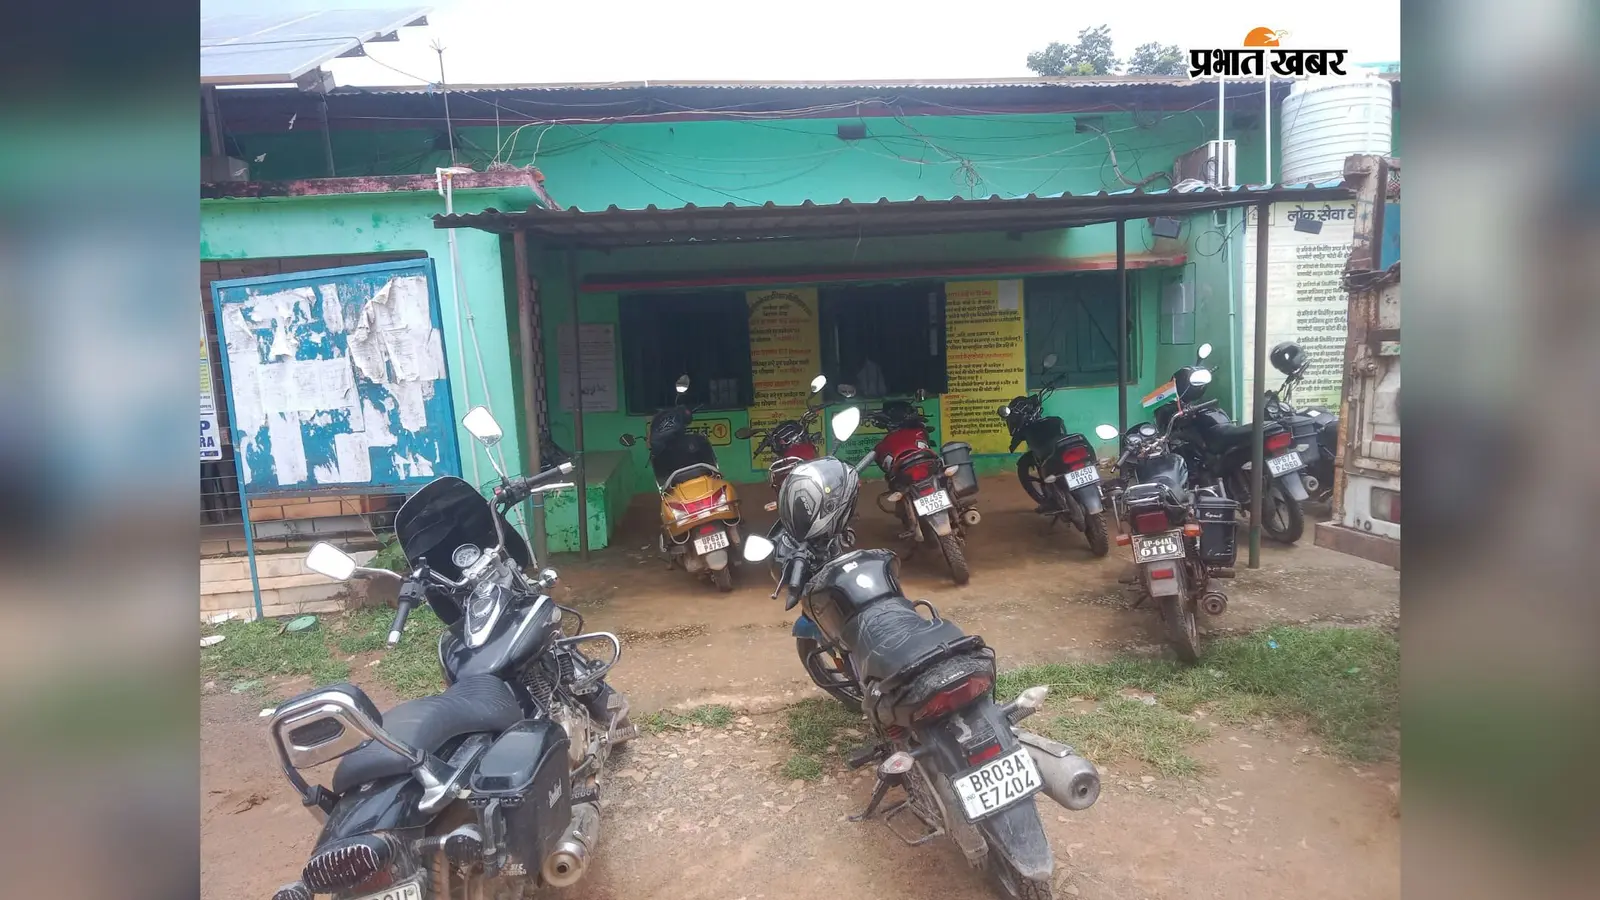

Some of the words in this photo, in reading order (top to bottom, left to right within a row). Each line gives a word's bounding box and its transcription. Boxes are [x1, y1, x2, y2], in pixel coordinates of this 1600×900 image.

[1318, 204, 1346, 220] सेवा
[1076, 474, 1094, 485] 1310
[926, 500, 944, 512] 1702
[1140, 544, 1178, 556] 6119
[969, 754, 1026, 793] BR03A
[978, 770, 1035, 811] E7404
